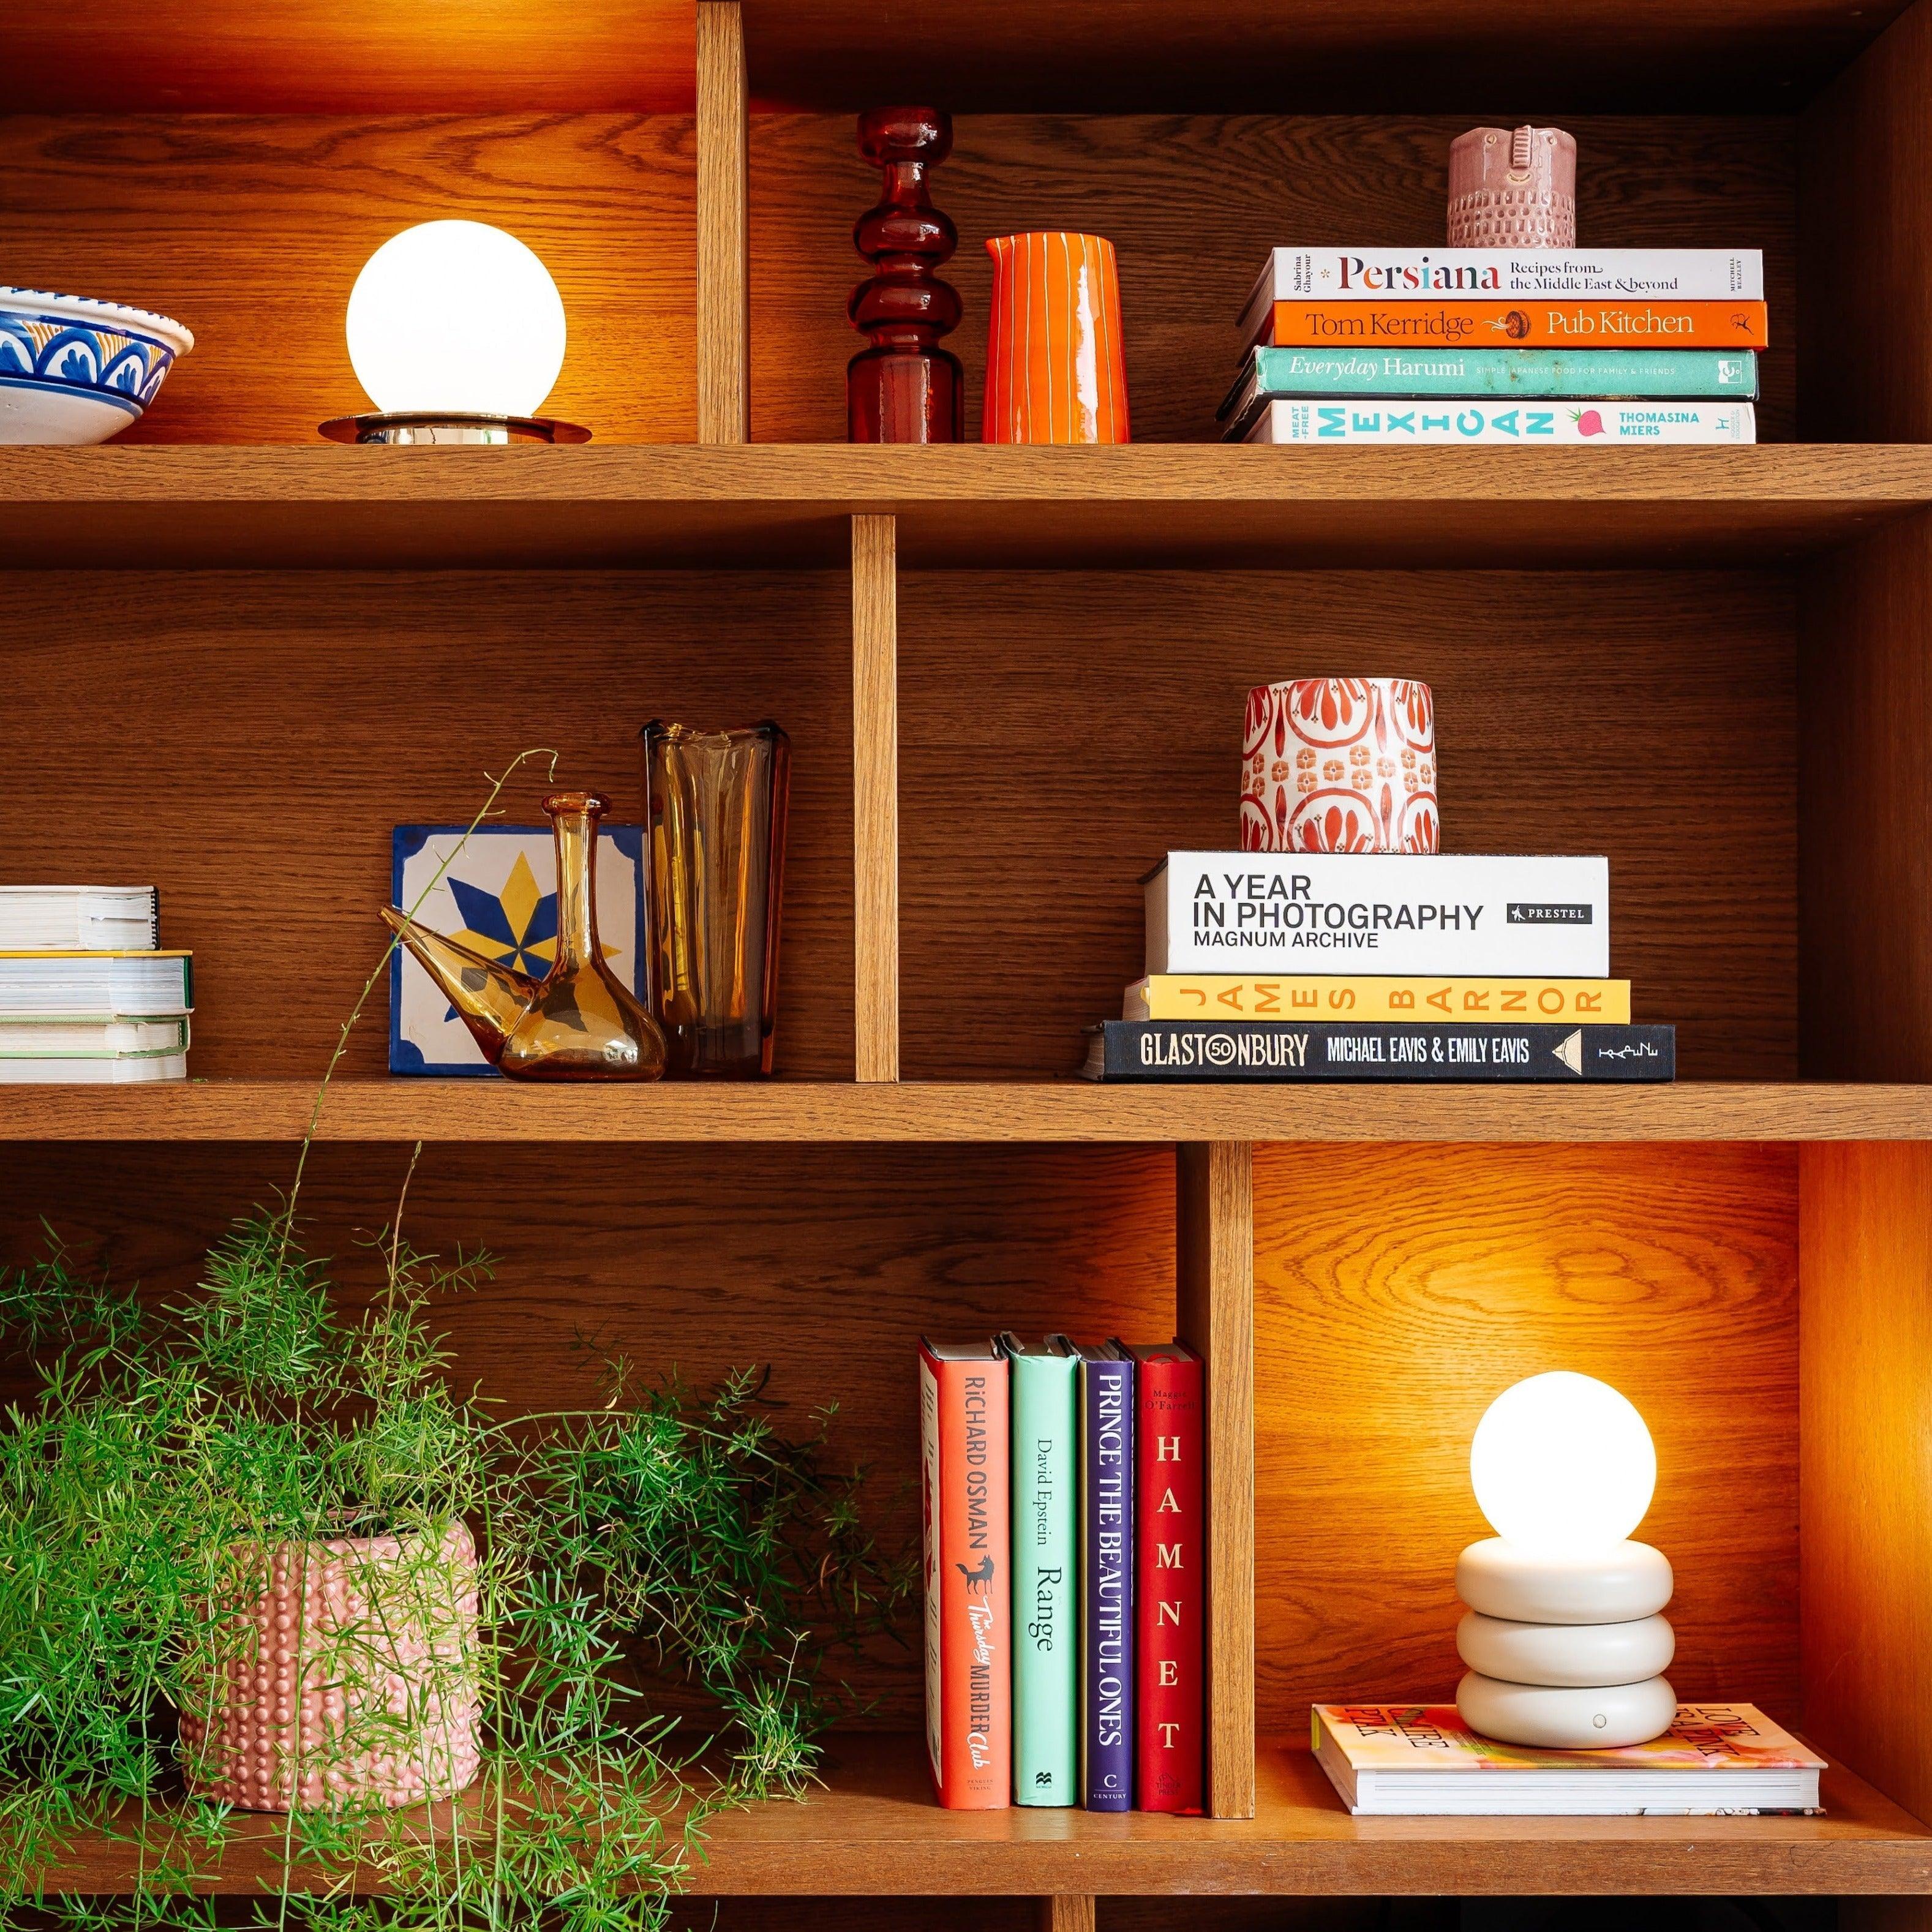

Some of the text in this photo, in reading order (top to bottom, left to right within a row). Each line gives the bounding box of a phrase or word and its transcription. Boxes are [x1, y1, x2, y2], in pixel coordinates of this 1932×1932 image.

[1302, 254, 1312, 293] Ghayour
[1337, 257, 1502, 290] Persiana
[1511, 261, 1603, 276] Recipes from
[1511, 277, 1531, 290] the
[1534, 277, 1582, 290] Middle
[1585, 278, 1612, 290] East
[1306, 310, 1474, 342] Tom Kerridge
[1547, 309, 1694, 334] Pub Kitchen
[1289, 356, 1465, 381] Everyday Harumi
[1317, 407, 1554, 438] MEXICAN
[1620, 412, 1700, 423] THOMASINA
[1620, 425, 1660, 436] MIERS
[1194, 874, 1312, 900] A YEAR
[1193, 902, 1484, 930] IN PHOTOGRAPHY
[1528, 909, 1584, 919] PRESTEL
[1194, 931, 1379, 949] MAGNUM ARCHIVE
[1179, 983, 1602, 1014] JAMES BARNOR
[1327, 1037, 1530, 1064] MICHAEL EAVIS & EMILY EAVIS
[1153, 1389, 1186, 1399] Maggie
[1032, 1439, 1053, 1546] David Epstein
[967, 1471, 988, 1549] OSMAN
[1098, 1375, 1122, 1746] PRINCE THE BEAUTIFUL ONES
[1156, 1435, 1185, 1749] HAMNET
[1028, 1566, 1062, 1652] Range
[970, 1664, 990, 1734] MURDER
[1344, 1707, 1397, 1737] PTAK
[1387, 1707, 1450, 1748] CLAIRE
[1695, 1707, 1761, 1736] LOVE
[966, 1732, 991, 1770] Club
[1675, 1728, 1740, 1757] PINK
[1103, 1774, 1118, 1788] C
